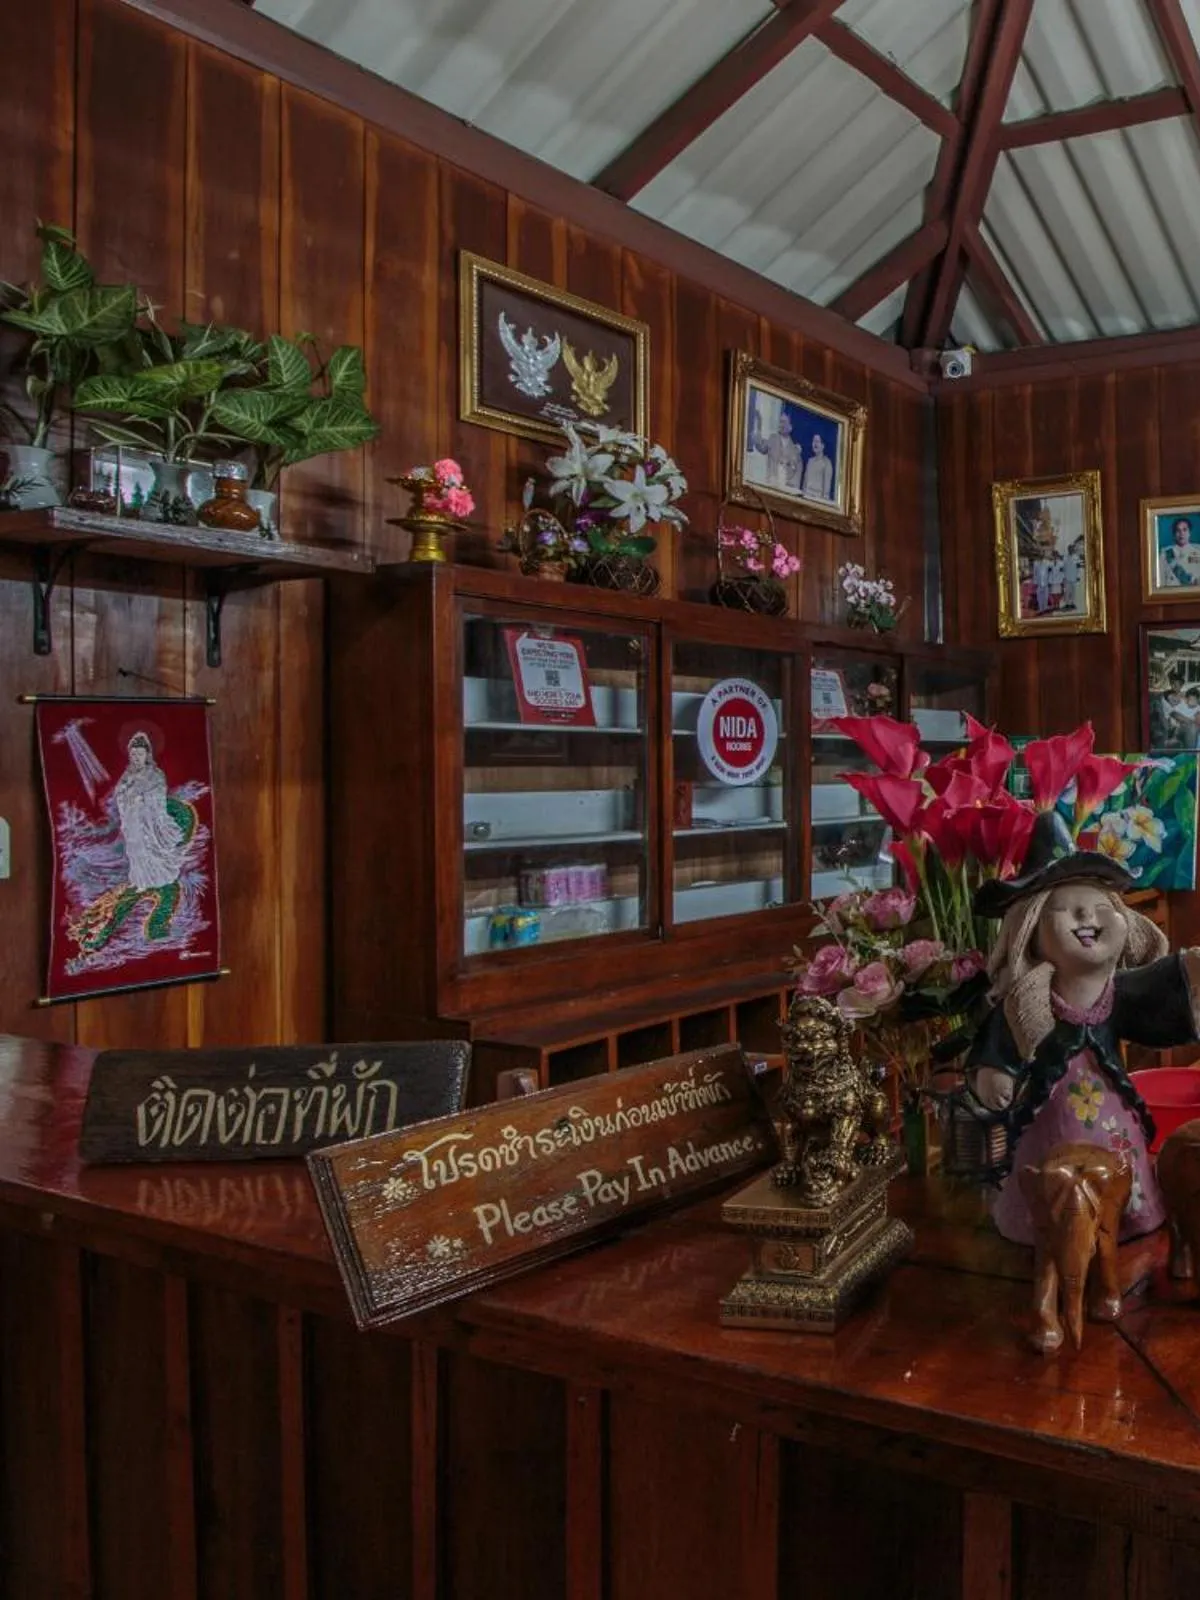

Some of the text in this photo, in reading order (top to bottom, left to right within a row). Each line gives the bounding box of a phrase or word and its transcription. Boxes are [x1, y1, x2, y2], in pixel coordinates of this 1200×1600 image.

[717, 684, 756, 700] PARTNER
[719, 716, 758, 739] NIDA
[136, 1051, 399, 1149] ติดต่อที่พัก
[473, 1133, 765, 1245] Please Pay In Advance.
